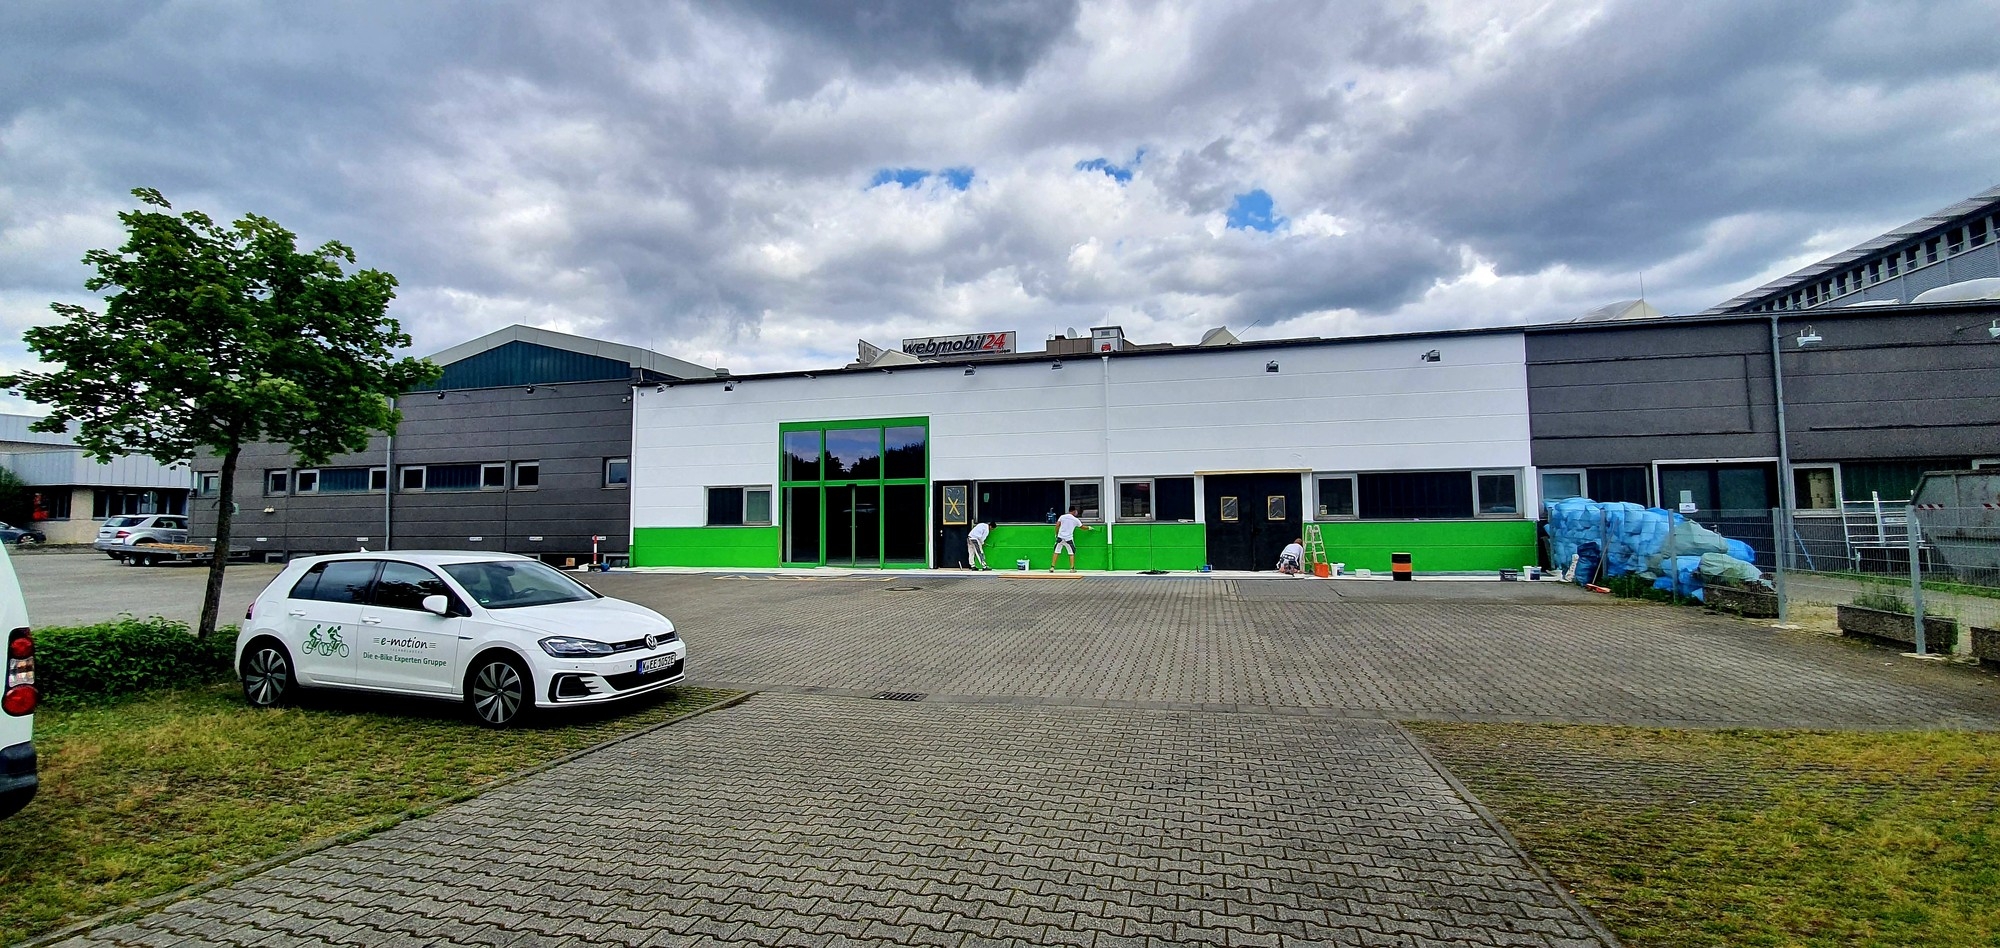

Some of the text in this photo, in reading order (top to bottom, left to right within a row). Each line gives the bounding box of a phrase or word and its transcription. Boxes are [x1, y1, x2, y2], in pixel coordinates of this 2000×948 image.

[903, 335, 1006, 354] webmobil24
[381, 637, 428, 649] e-motion
[363, 652, 446, 668] Die e-Bike Experten Gruppe
